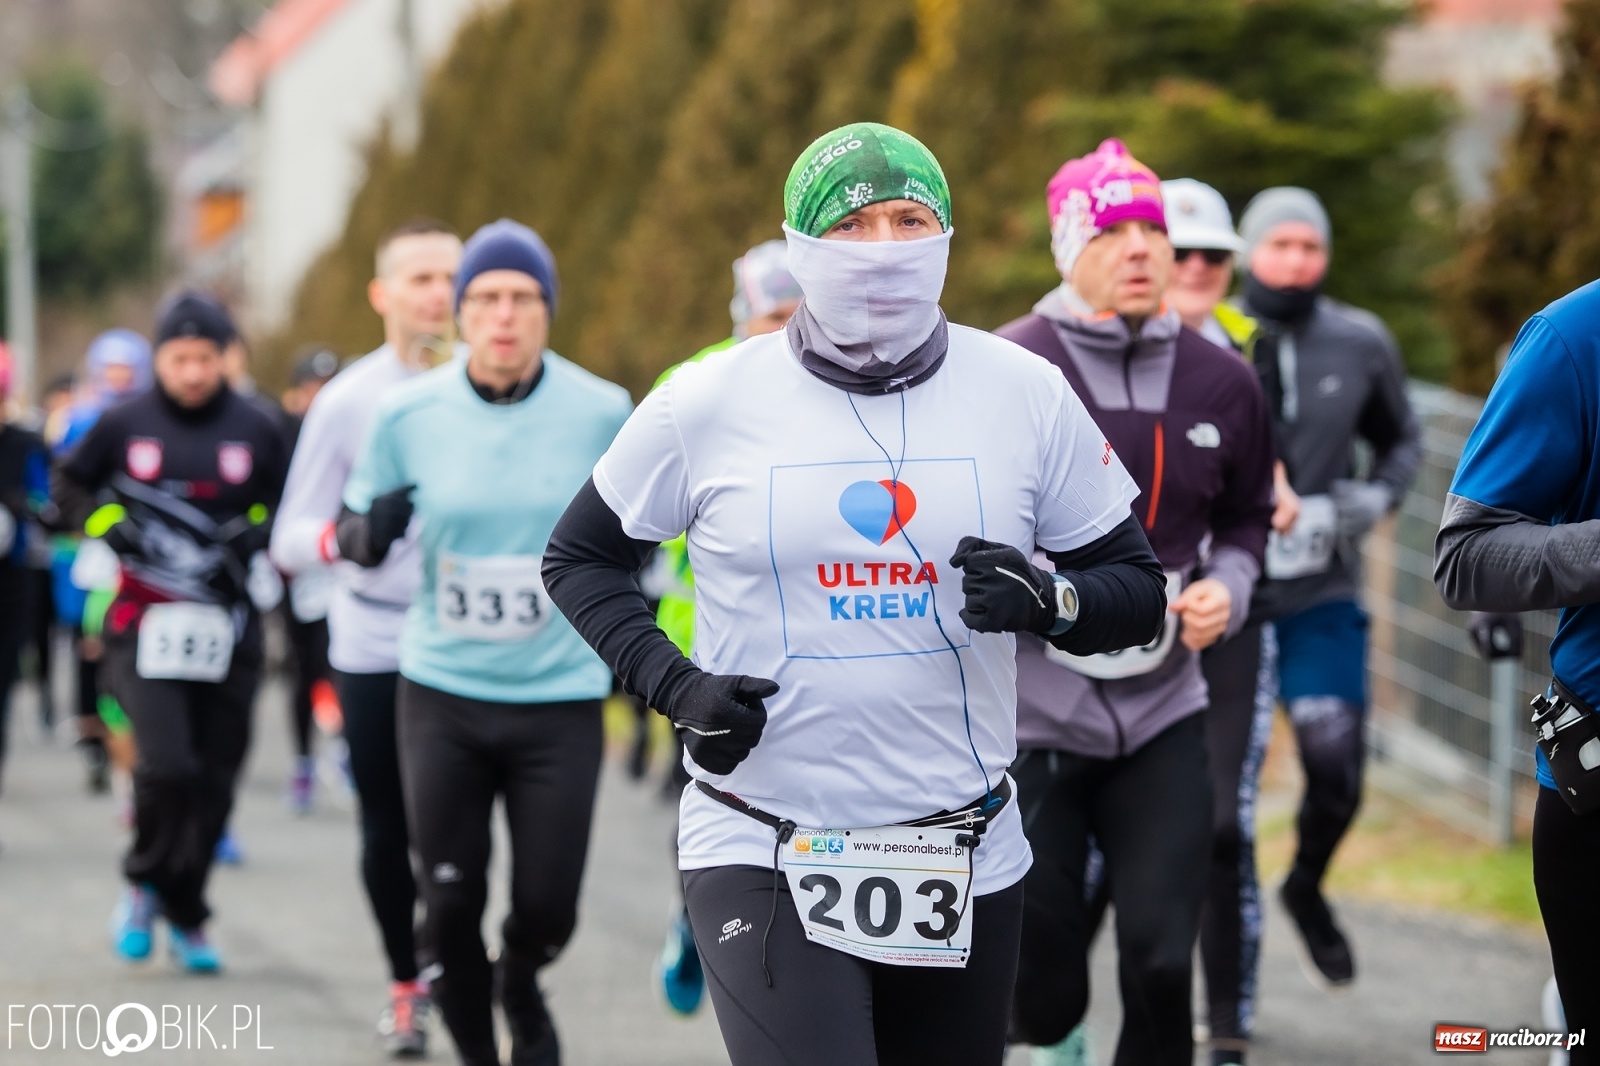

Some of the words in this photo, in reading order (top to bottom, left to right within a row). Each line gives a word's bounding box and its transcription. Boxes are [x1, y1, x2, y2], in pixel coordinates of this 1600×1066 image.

[817, 561, 939, 588] ULTRA
[446, 583, 542, 625] 333
[829, 591, 929, 621] KREW
[853, 841, 965, 857] www.personalbest.pl
[799, 873, 961, 941] 203
